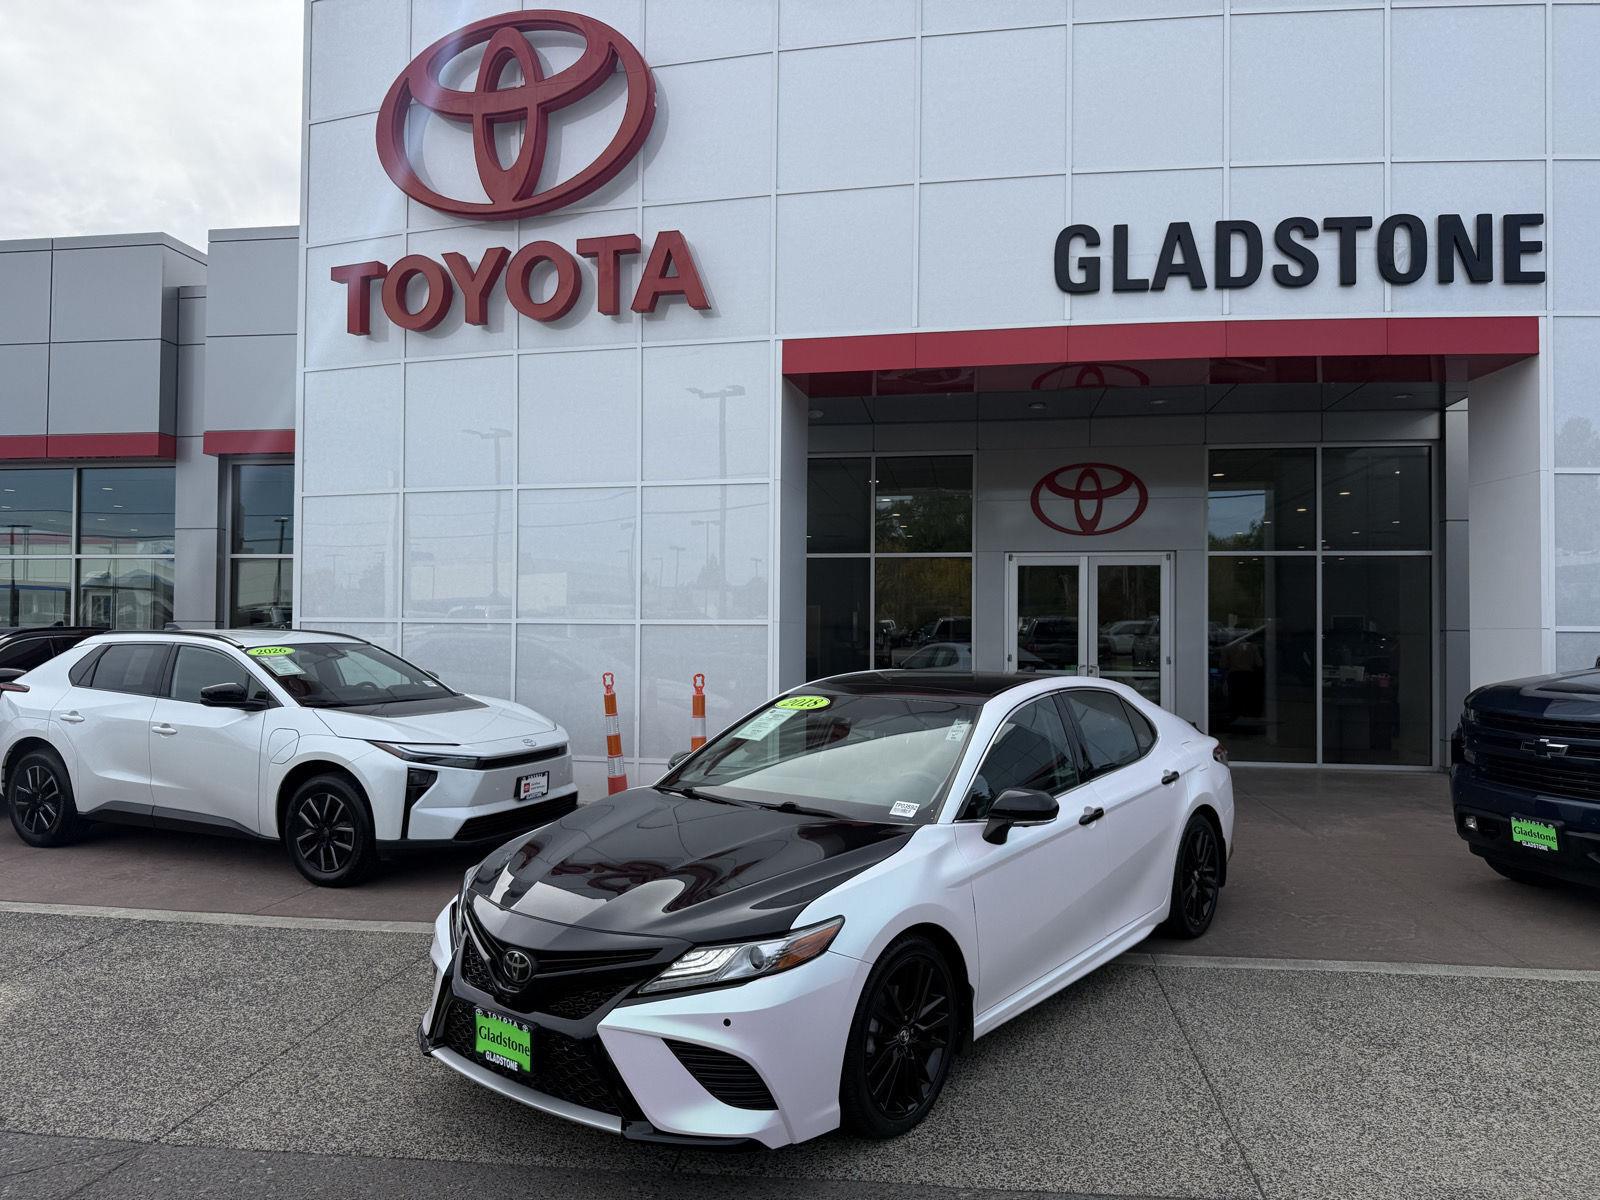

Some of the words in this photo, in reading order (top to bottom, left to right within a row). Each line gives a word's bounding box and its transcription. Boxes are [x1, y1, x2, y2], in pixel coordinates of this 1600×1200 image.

[1054, 213, 1546, 293] GLADSTONE
[331, 230, 712, 336] TOYOTA
[256, 647, 287, 655] 2026
[780, 698, 824, 707] 2018
[1513, 825, 1557, 843] Gladstone
[487, 1011, 519, 1028] TOYOTA
[478, 1025, 530, 1057] Gladstone
[485, 1050, 519, 1072] GLADSTONE
